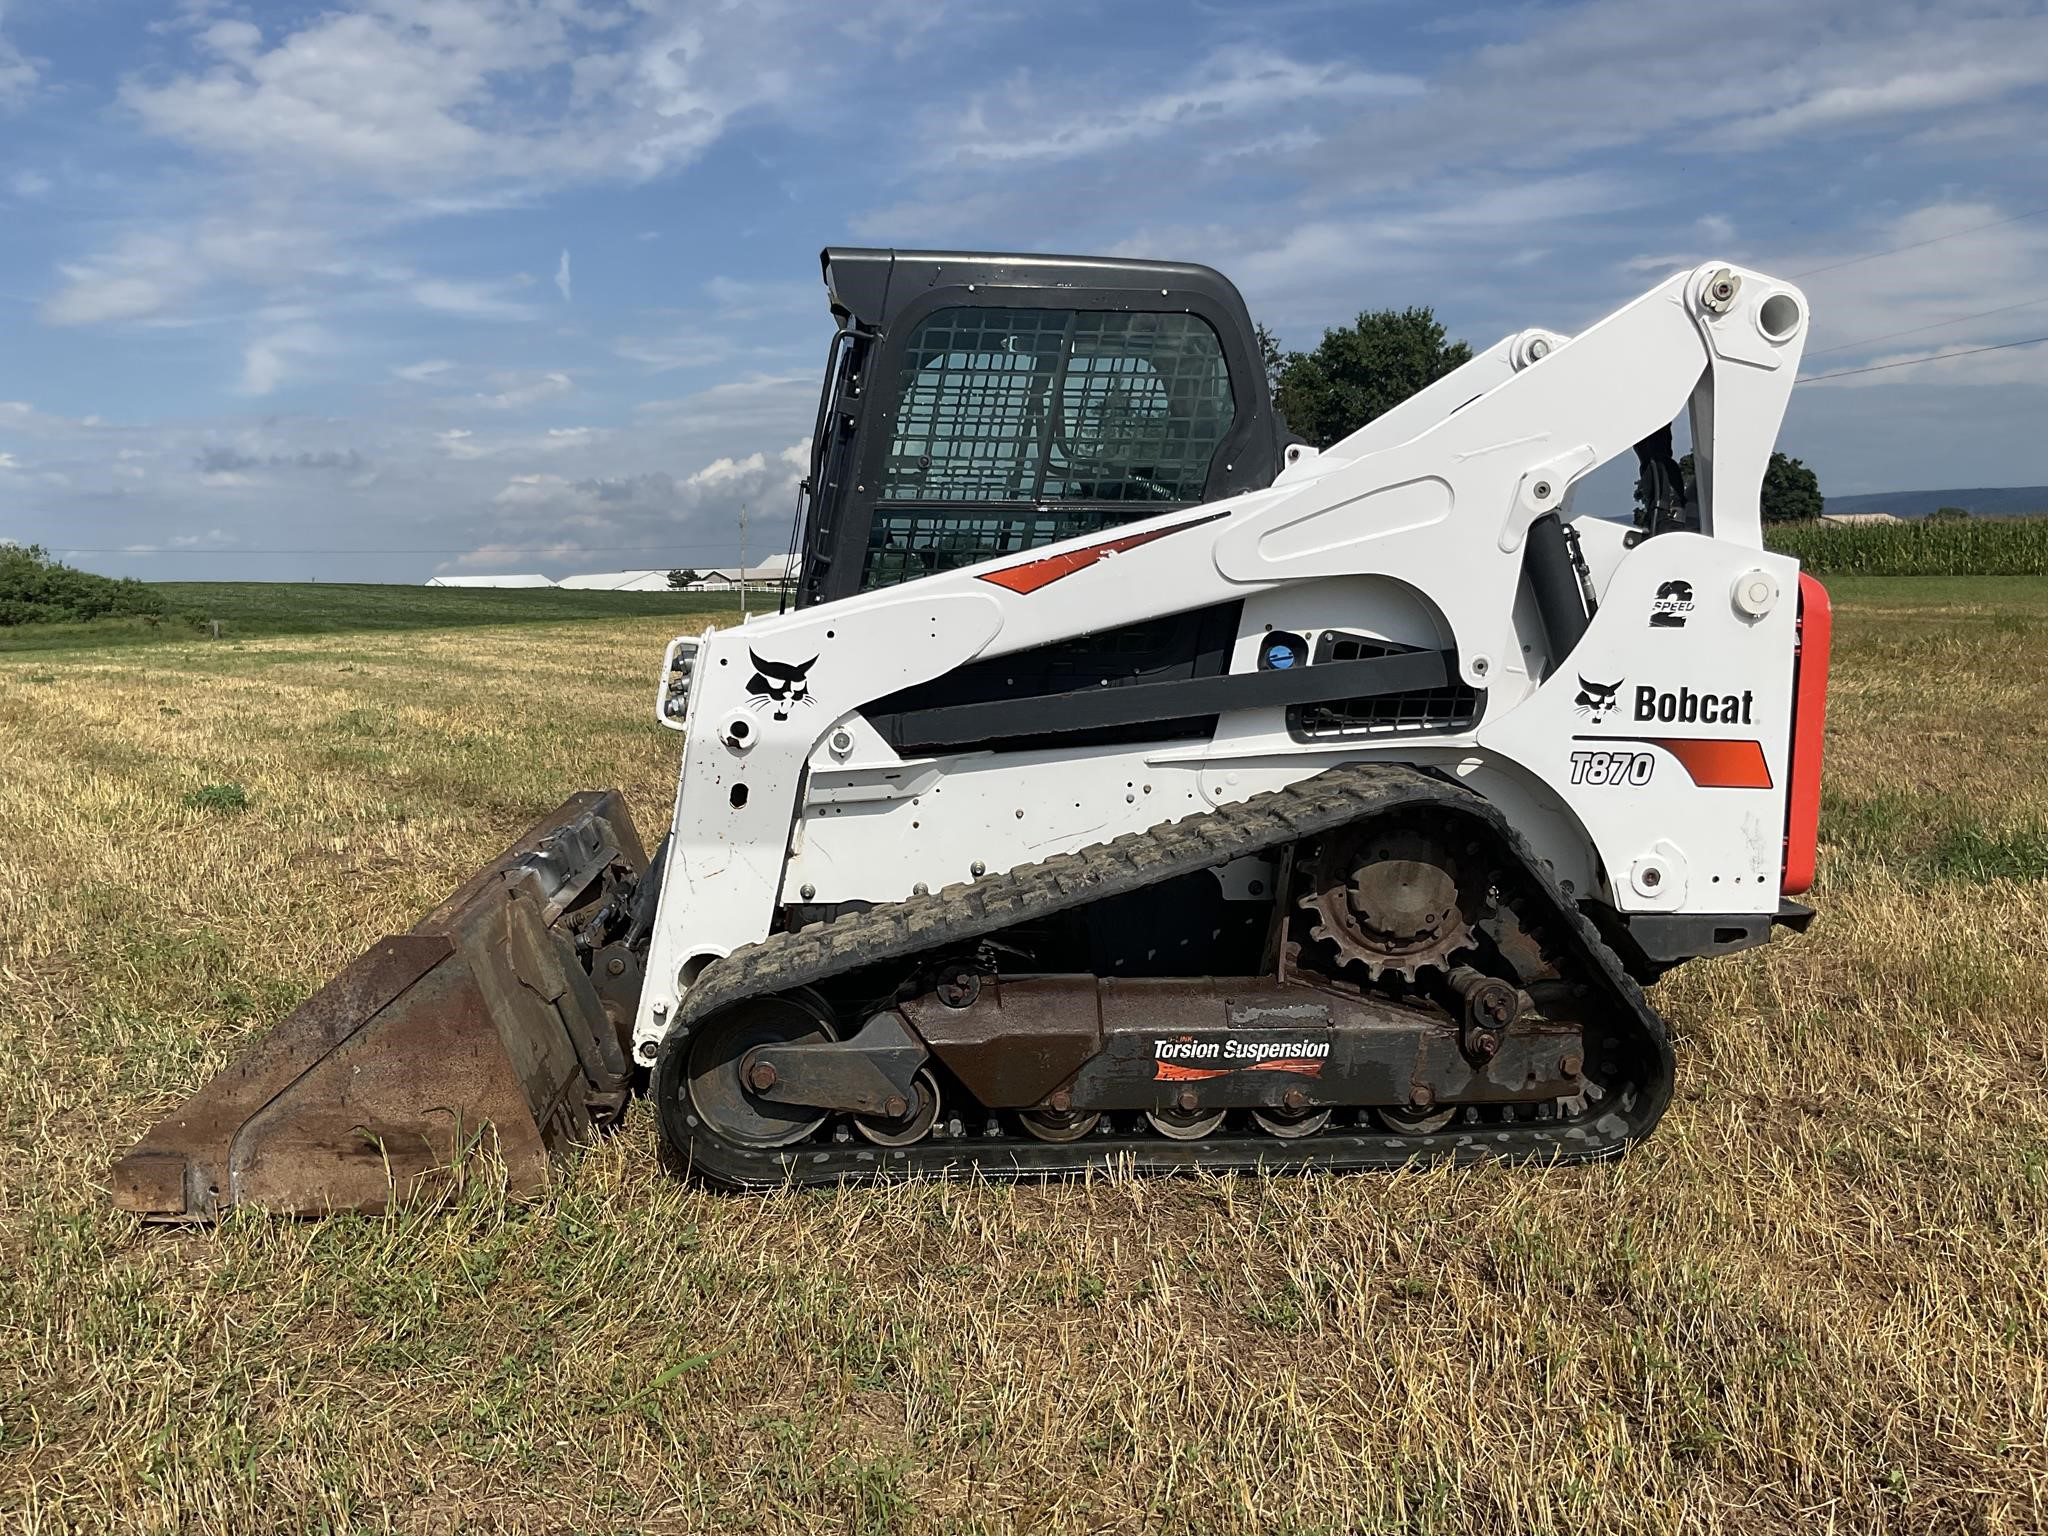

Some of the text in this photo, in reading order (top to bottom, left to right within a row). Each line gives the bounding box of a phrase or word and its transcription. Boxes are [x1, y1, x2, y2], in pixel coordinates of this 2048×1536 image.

[1648, 580, 1693, 628] 2
[1652, 601, 1695, 612] SPEED
[1634, 686, 1753, 725] Bobcat
[1570, 751, 1655, 786] T870
[1154, 1039, 1330, 1061] Torsion Suspension
